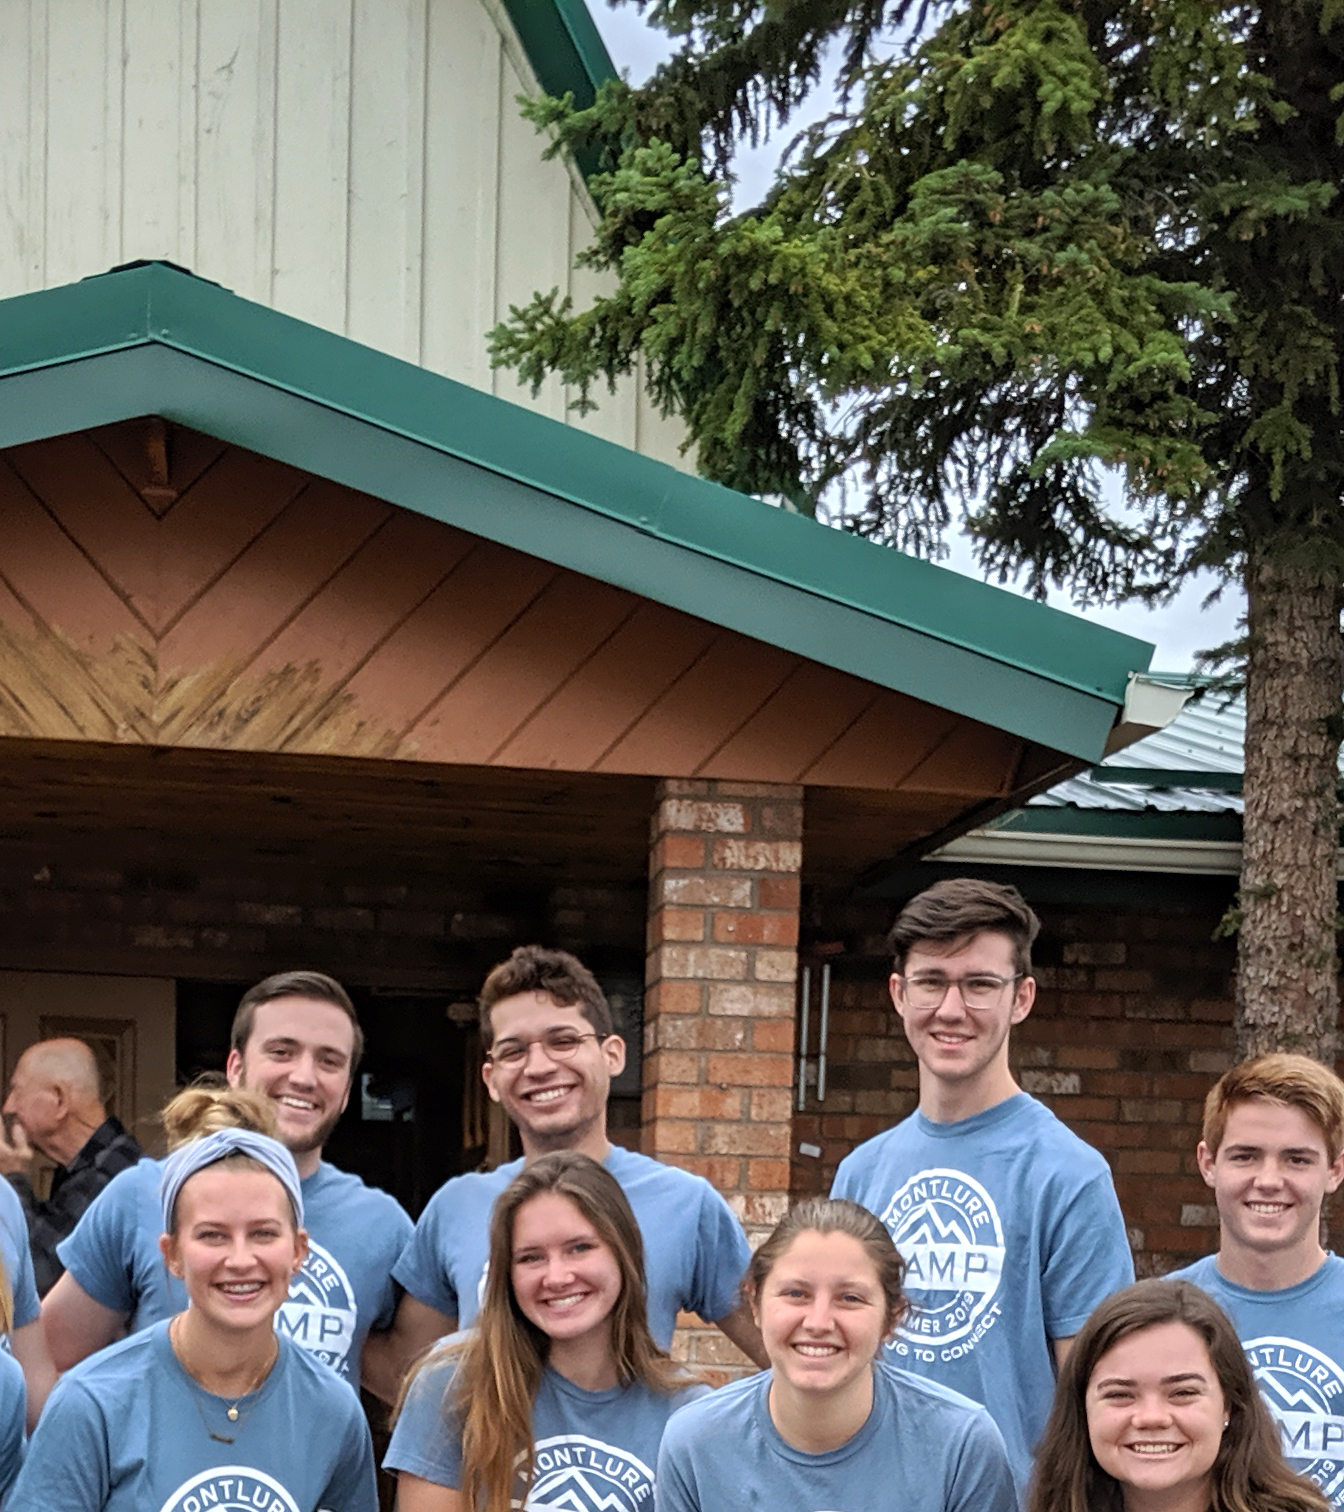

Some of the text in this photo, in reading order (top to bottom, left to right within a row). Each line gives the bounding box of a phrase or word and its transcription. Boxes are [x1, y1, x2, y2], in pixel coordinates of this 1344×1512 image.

[887, 1180, 990, 1229] MONTLURE
[906, 1251, 988, 1284] AMP
[278, 1309, 344, 1344] MP
[945, 1292, 975, 1329] 2019
[914, 1348, 936, 1363] TO
[1247, 1348, 1343, 1399] NTLURE
[1278, 1419, 1344, 1451] MP
[1310, 1461, 1337, 1487] 019
